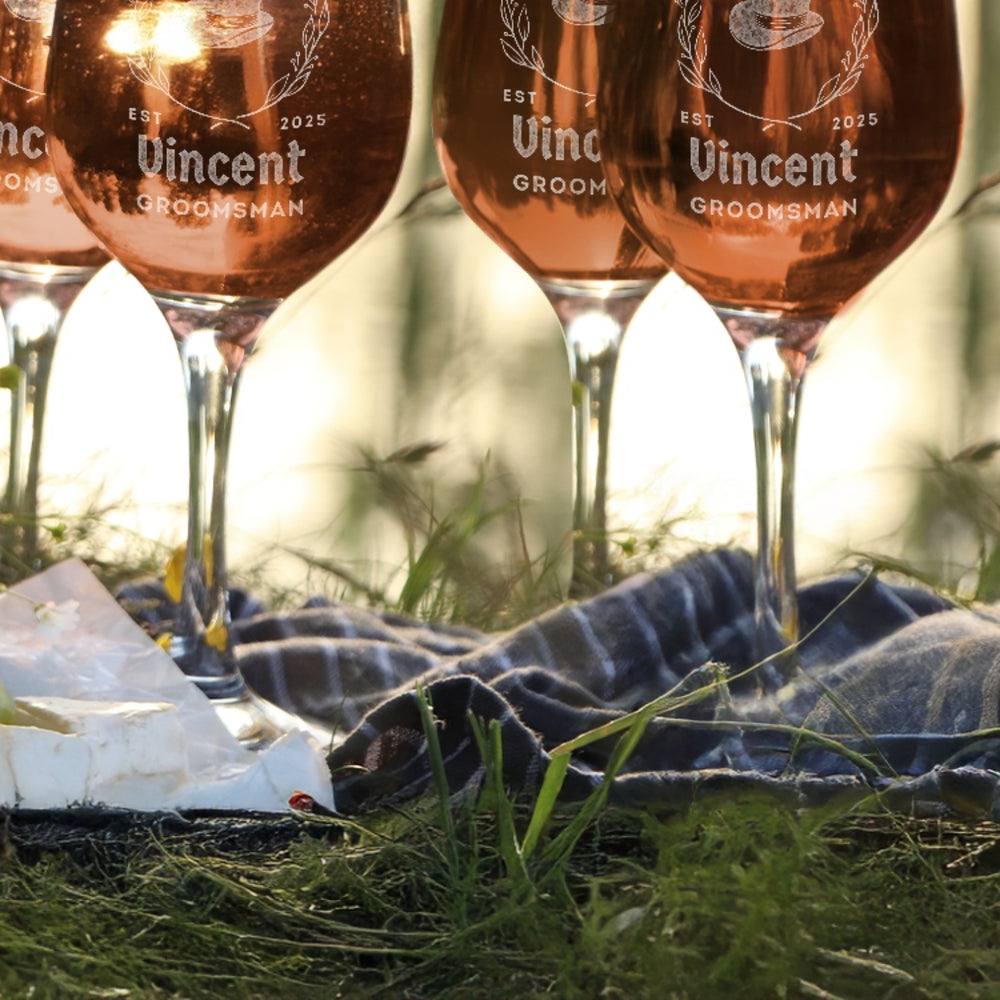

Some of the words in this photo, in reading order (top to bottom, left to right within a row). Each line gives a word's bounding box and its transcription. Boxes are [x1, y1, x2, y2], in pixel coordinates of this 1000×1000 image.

[503, 89, 536, 105] EST
[128, 107, 162, 125] EST
[280, 113, 326, 130] 2025
[680, 111, 714, 128] EST
[832, 112, 878, 130] 2025
[513, 114, 600, 163] Vinc
[138, 133, 306, 186] Vincent
[690, 136, 858, 187] Vincent
[513, 174, 606, 196] GROOM
[137, 194, 304, 219] GROOMSMAN
[690, 197, 857, 221] GROOMSMAN
